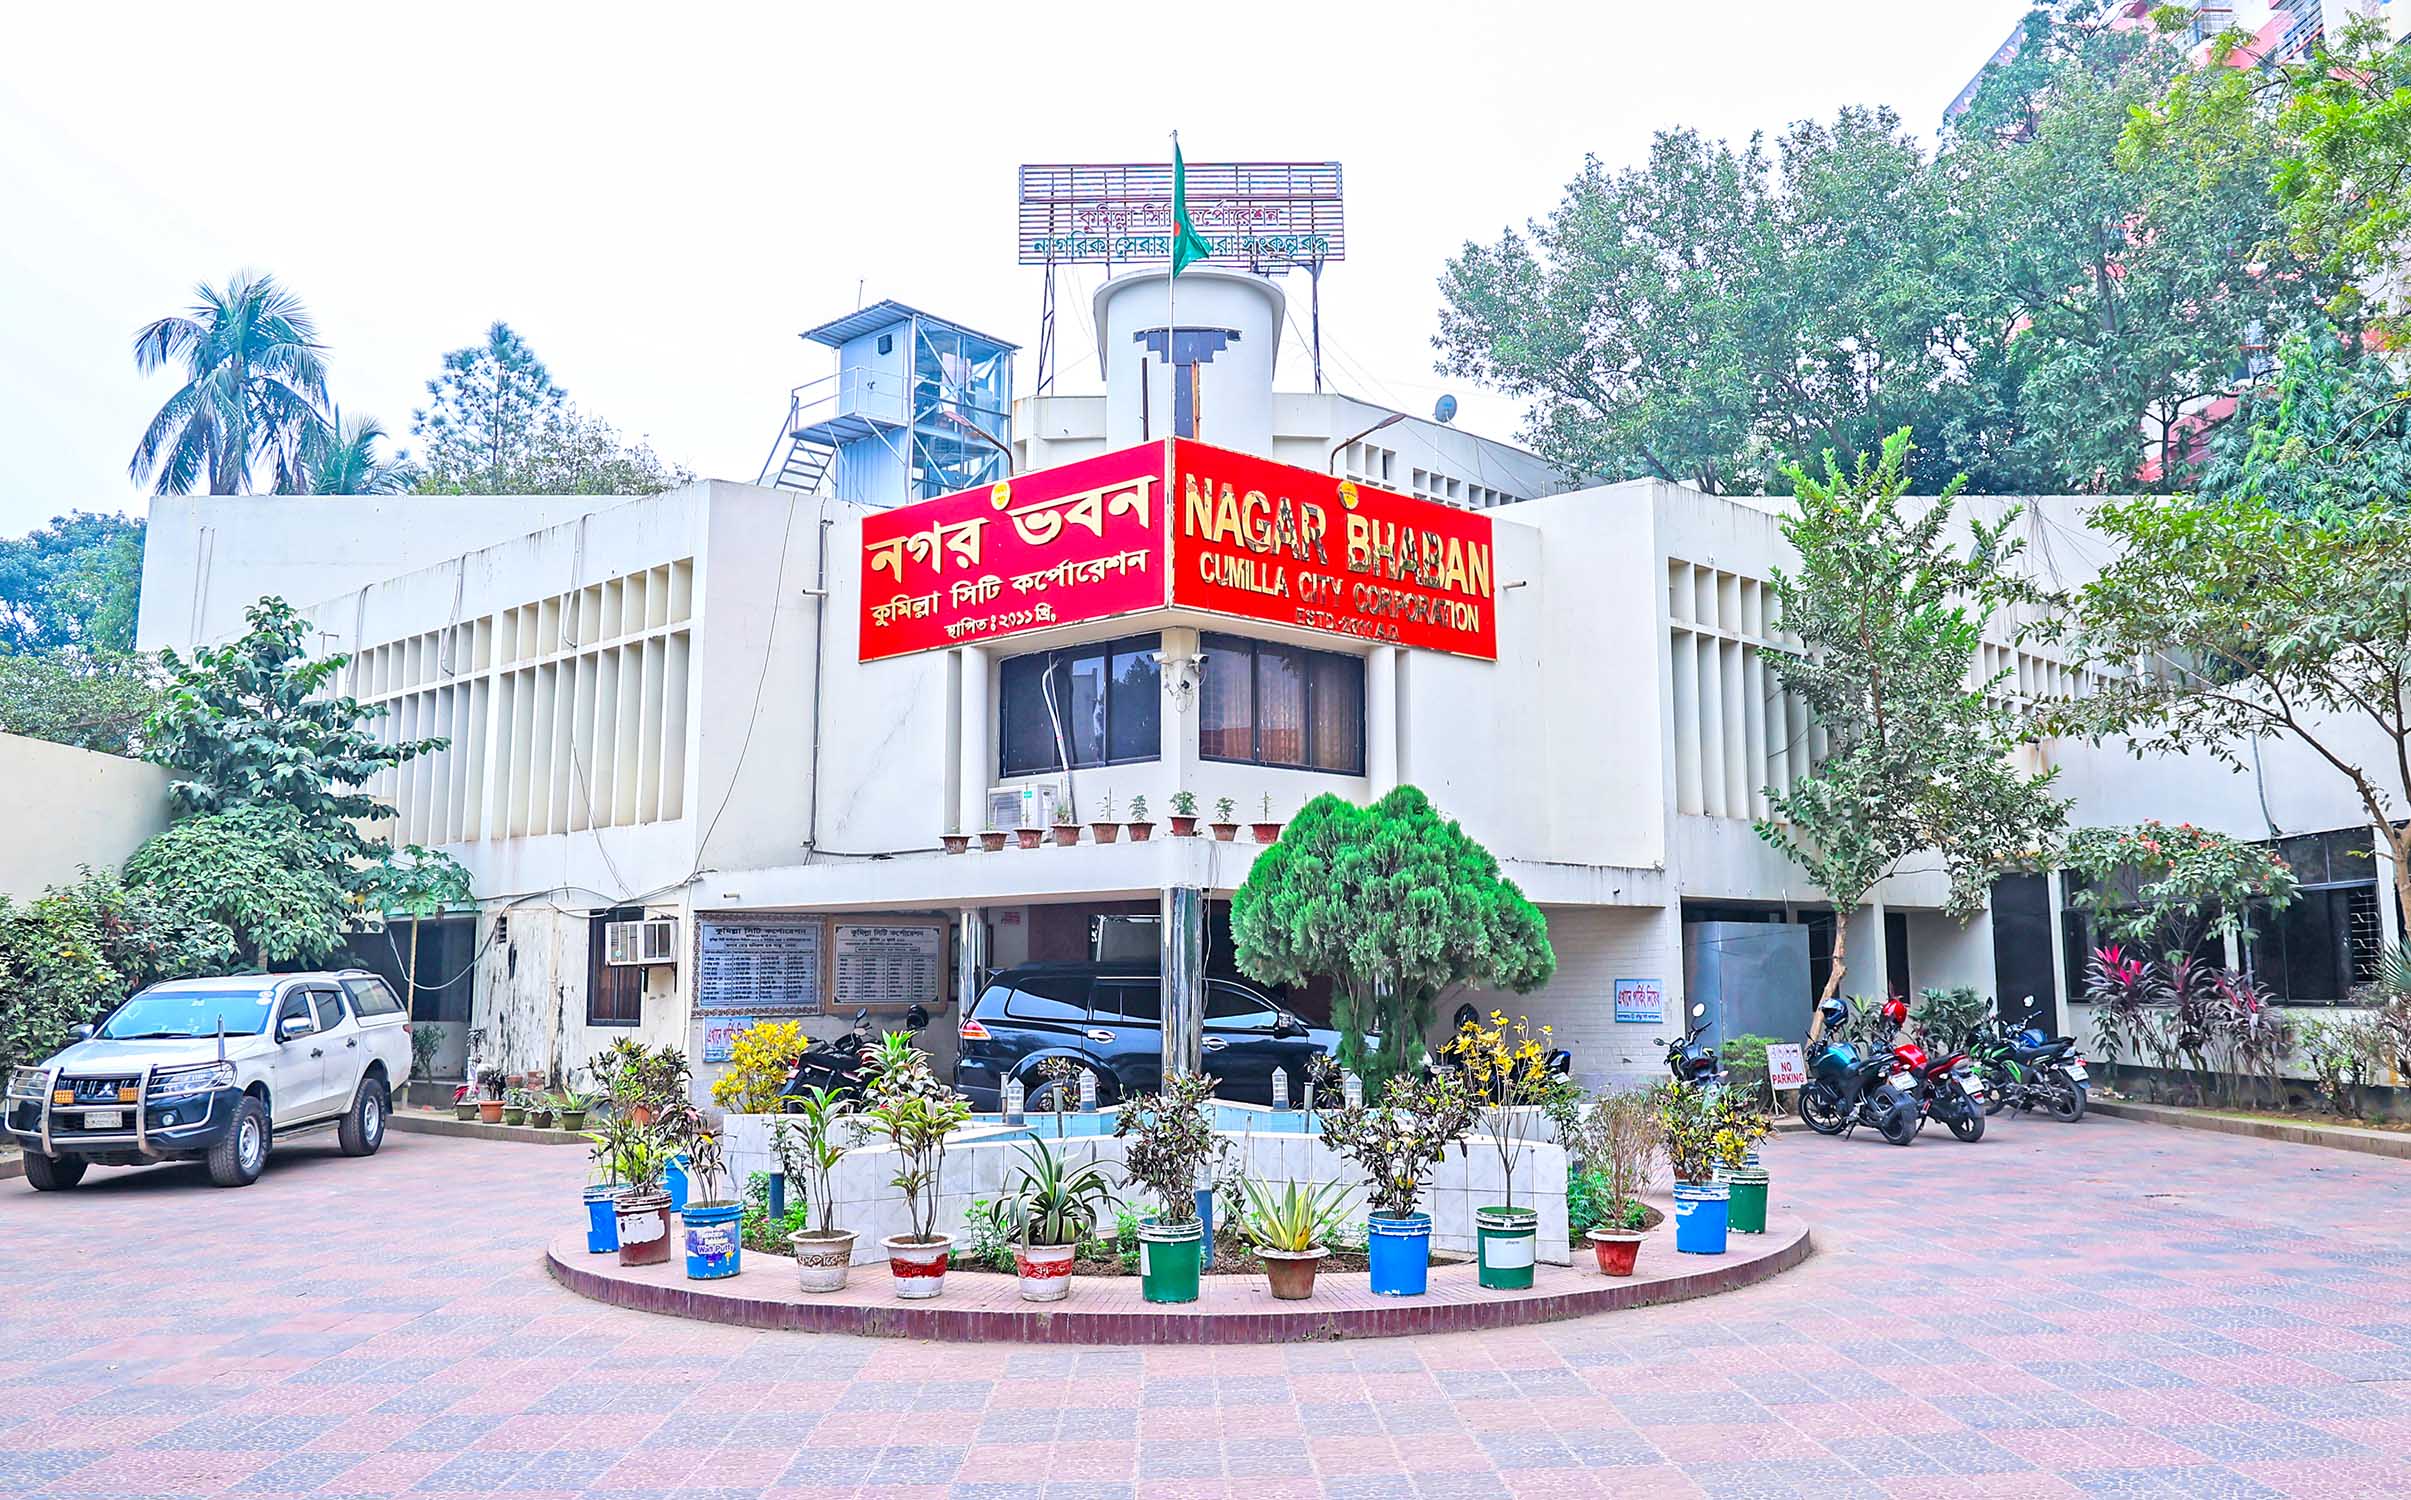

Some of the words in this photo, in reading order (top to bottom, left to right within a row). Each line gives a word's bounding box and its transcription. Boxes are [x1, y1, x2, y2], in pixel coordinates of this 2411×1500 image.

[1080, 204, 1134, 232] কুমিল্লা
[1033, 230, 1106, 257] নাগরিক
[865, 517, 990, 583] নগর
[1005, 475, 1159, 545] ভবন
[1185, 473, 1328, 565] NAGAR
[1346, 513, 1490, 598] BHABAN
[870, 590, 942, 627] কুমিল্লা
[948, 575, 1004, 609] সিটি
[1009, 549, 1151, 595] কর্পোরেশন
[1200, 552, 1289, 599] CUMILLA
[1298, 572, 1343, 607] CITY
[1353, 582, 1479, 633] CORPORATION
[999, 610, 1033, 628] ২০১১
[1772, 1073, 1805, 1084] PARKING
[1780, 1062, 1792, 1072] NO
